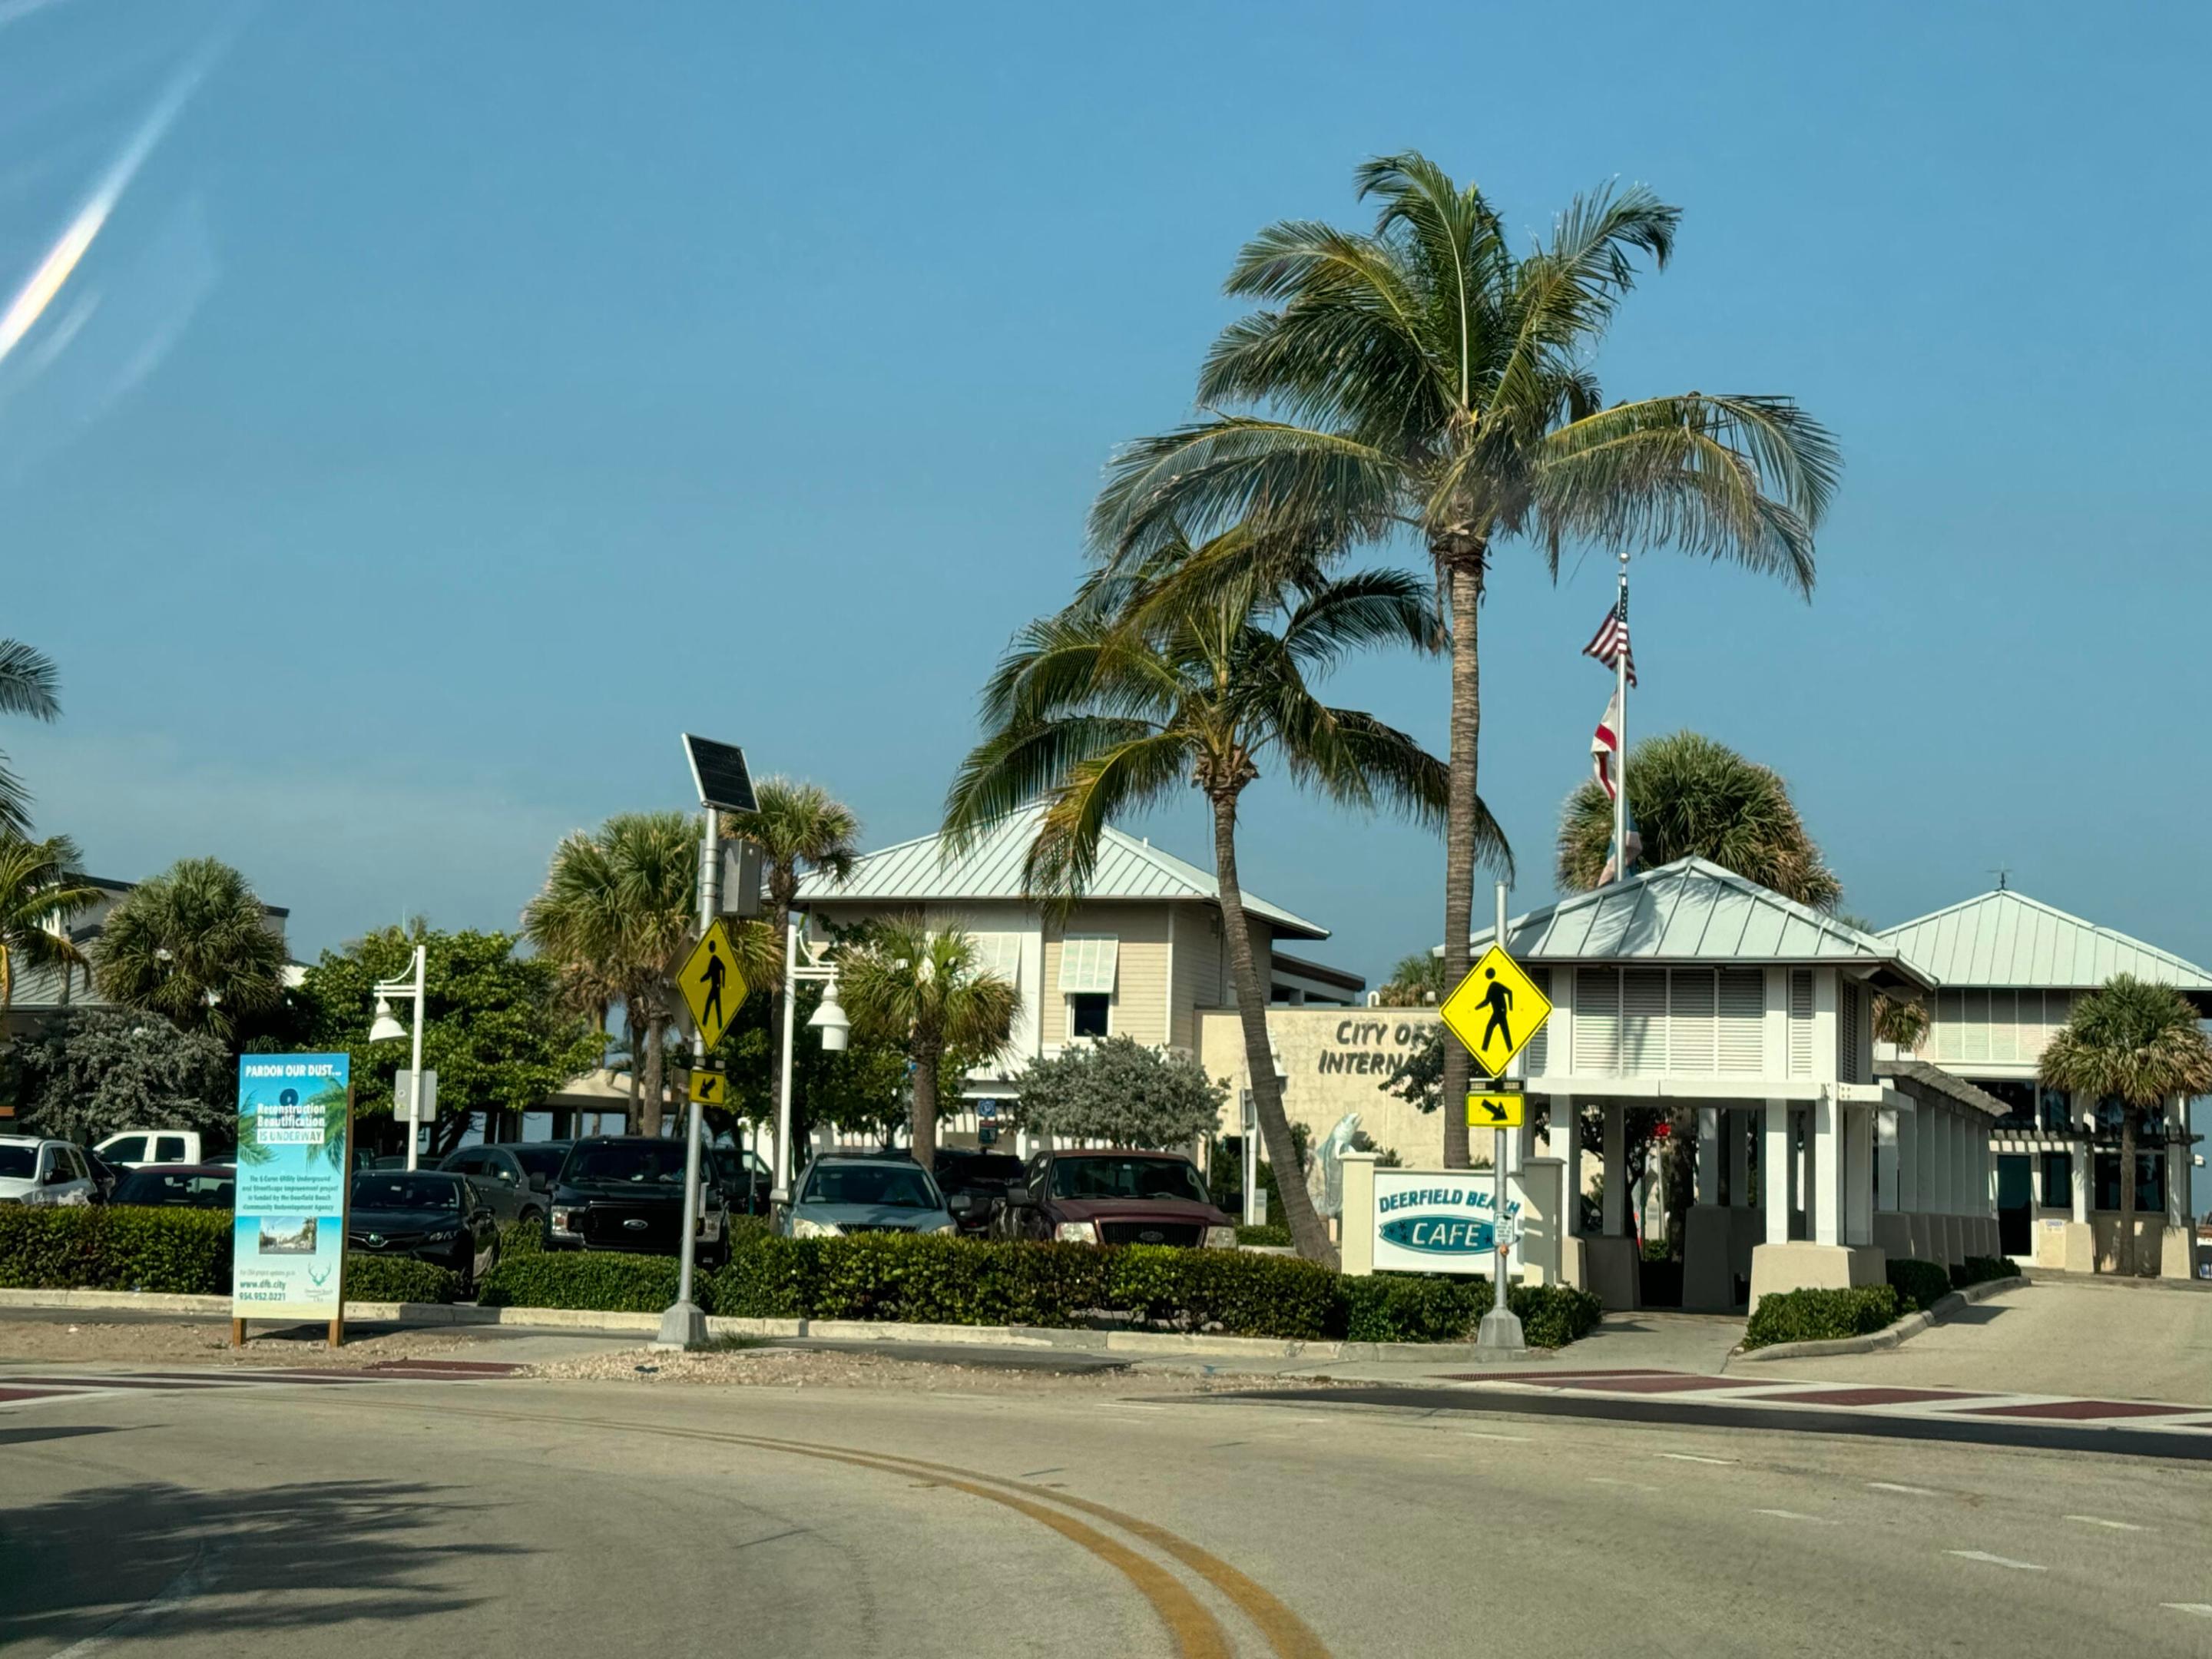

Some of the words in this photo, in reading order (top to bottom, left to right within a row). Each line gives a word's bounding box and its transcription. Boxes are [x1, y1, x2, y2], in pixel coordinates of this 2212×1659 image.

[1336, 1020, 1388, 1045] CITY
[1395, 1022, 1426, 1049] OF
[246, 1065, 283, 1077] PARDON
[285, 1065, 306, 1076] OUR
[308, 1065, 342, 1076] DUST...
[257, 1103, 326, 1114] Reconstruction
[257, 1115, 326, 1127] Beautification
[259, 1131, 268, 1141] IS
[269, 1131, 322, 1141] UNDERWAY
[1379, 1189, 1463, 1214] DEERFIELD
[1465, 1190, 1521, 1214] BEAH
[1412, 1223, 1482, 1247] CAFE
[240, 1279, 286, 1290] www.dfb.city
